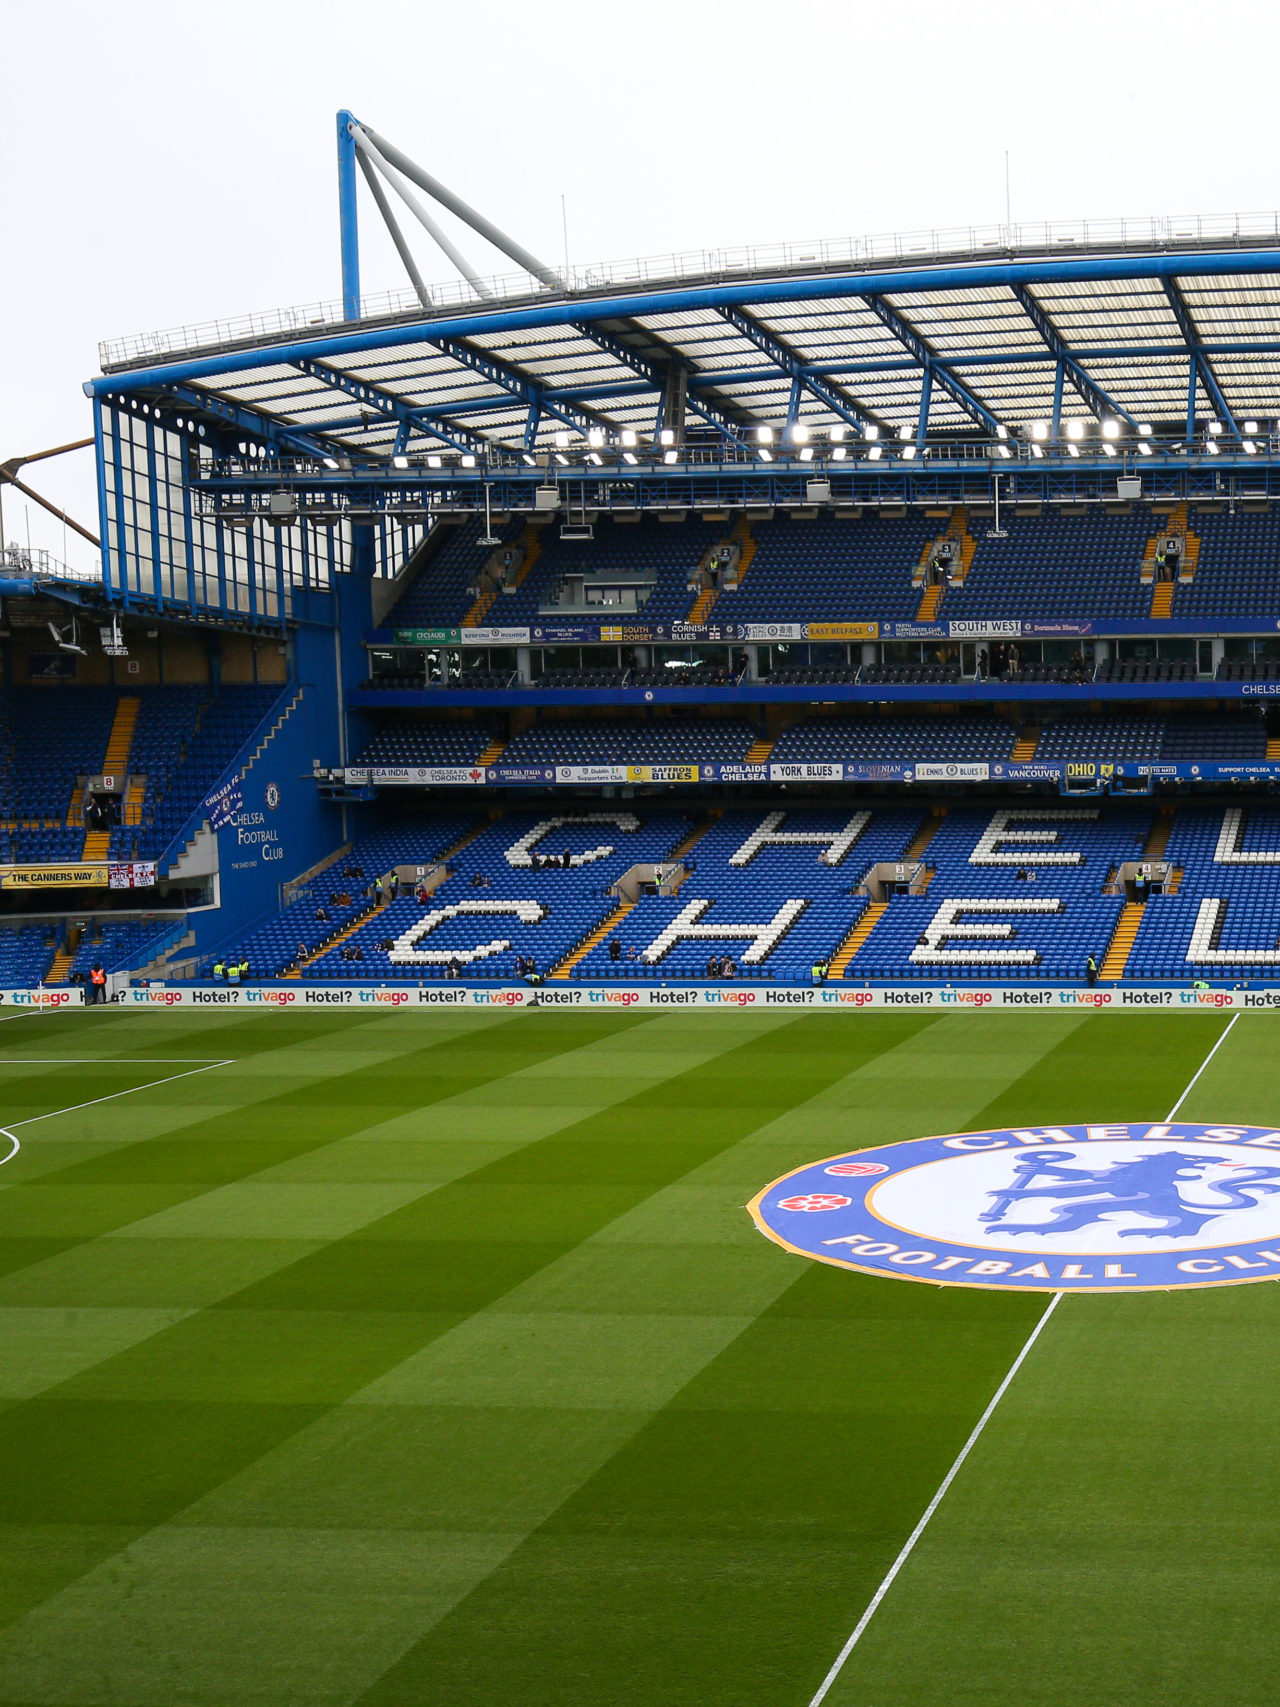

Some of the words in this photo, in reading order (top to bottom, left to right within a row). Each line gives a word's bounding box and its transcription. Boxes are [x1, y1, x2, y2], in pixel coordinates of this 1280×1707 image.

[671, 625, 708, 633] CORNISH
[951, 622, 988, 631] SOUTH
[992, 621, 1020, 630] WEST
[130, 662, 137, 671] 8
[388, 769, 409, 777] INDIA
[720, 765, 767, 773] ADELAIDE
[780, 766, 802, 776] YORK
[807, 765, 833, 775] BLUES
[858, 765, 901, 774] SLOVENIAN
[1008, 770, 1061, 778] VANCOUVER
[1067, 763, 1096, 776] OHIO
[105, 777, 113, 786] 8
[721, 773, 767, 781] CHELSEA
[205, 783, 232, 806] CHELSEA
[231, 775, 240, 787] FC
[230, 812, 265, 827] CHELSEA
[238, 828, 279, 845] FOOTBALL
[262, 844, 284, 860] CLUB
[12, 873, 29, 882] THE
[30, 873, 73, 882] CANNERS
[74, 872, 92, 880] WAY
[111, 872, 141, 880] CHELSEA
[12, 992, 69, 1006] trivago
[133, 990, 182, 1005] trivago
[192, 991, 239, 1002] Hotel?
[246, 990, 295, 1005] trivago
[305, 991, 352, 1002] Hotel?
[359, 990, 408, 1005] trivago
[419, 991, 466, 1003] Hotel?
[473, 991, 523, 1005] trivago
[535, 992, 581, 1003] Hotel?
[588, 990, 639, 1005] trivago
[650, 991, 698, 1003] Hotel?
[705, 990, 755, 1005] trivago
[766, 991, 814, 1003] Hotel?
[821, 990, 873, 1005] trivago
[884, 992, 933, 1003] Hotel?
[940, 991, 992, 1006] trivago
[1003, 992, 1052, 1003] Hotel?
[1059, 991, 1111, 1006] trivago
[1122, 992, 1172, 1003] Hotel?
[1180, 991, 1233, 1006] trivago
[822, 1233, 1138, 1280] FOOTBALL
